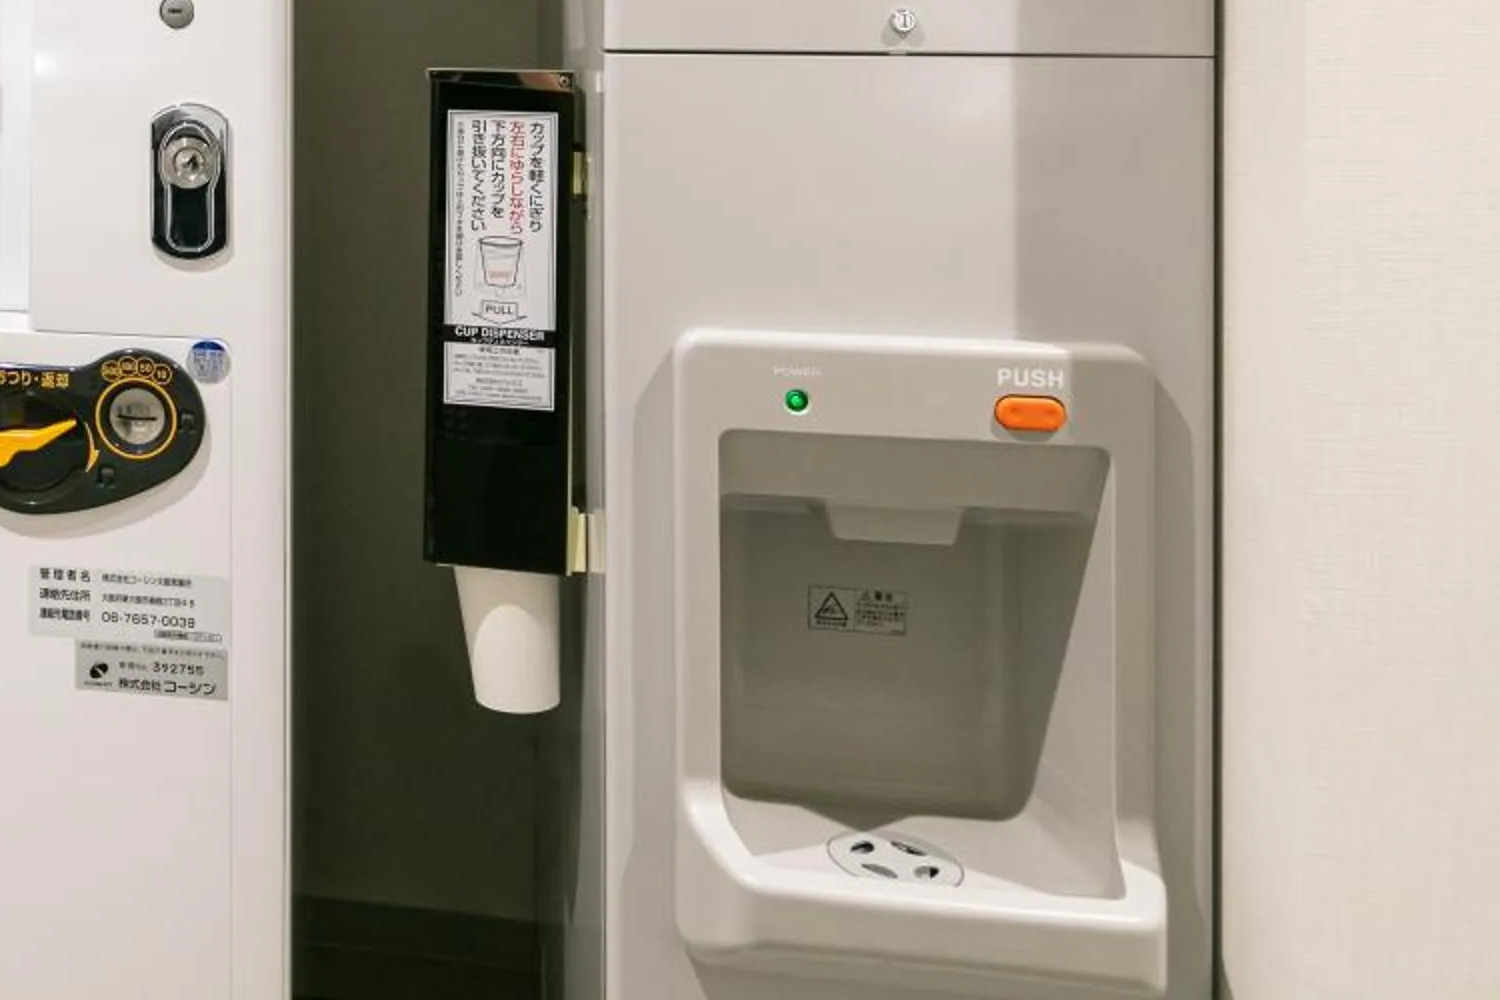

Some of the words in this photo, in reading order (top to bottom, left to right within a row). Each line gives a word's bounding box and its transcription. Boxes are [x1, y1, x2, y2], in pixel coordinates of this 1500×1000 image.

[485, 304, 514, 316] PULL
[454, 326, 478, 337] CUP
[480, 328, 545, 342] DISPENSER
[996, 367, 1066, 388] PUSH
[39, 567, 91, 583] 管理者名
